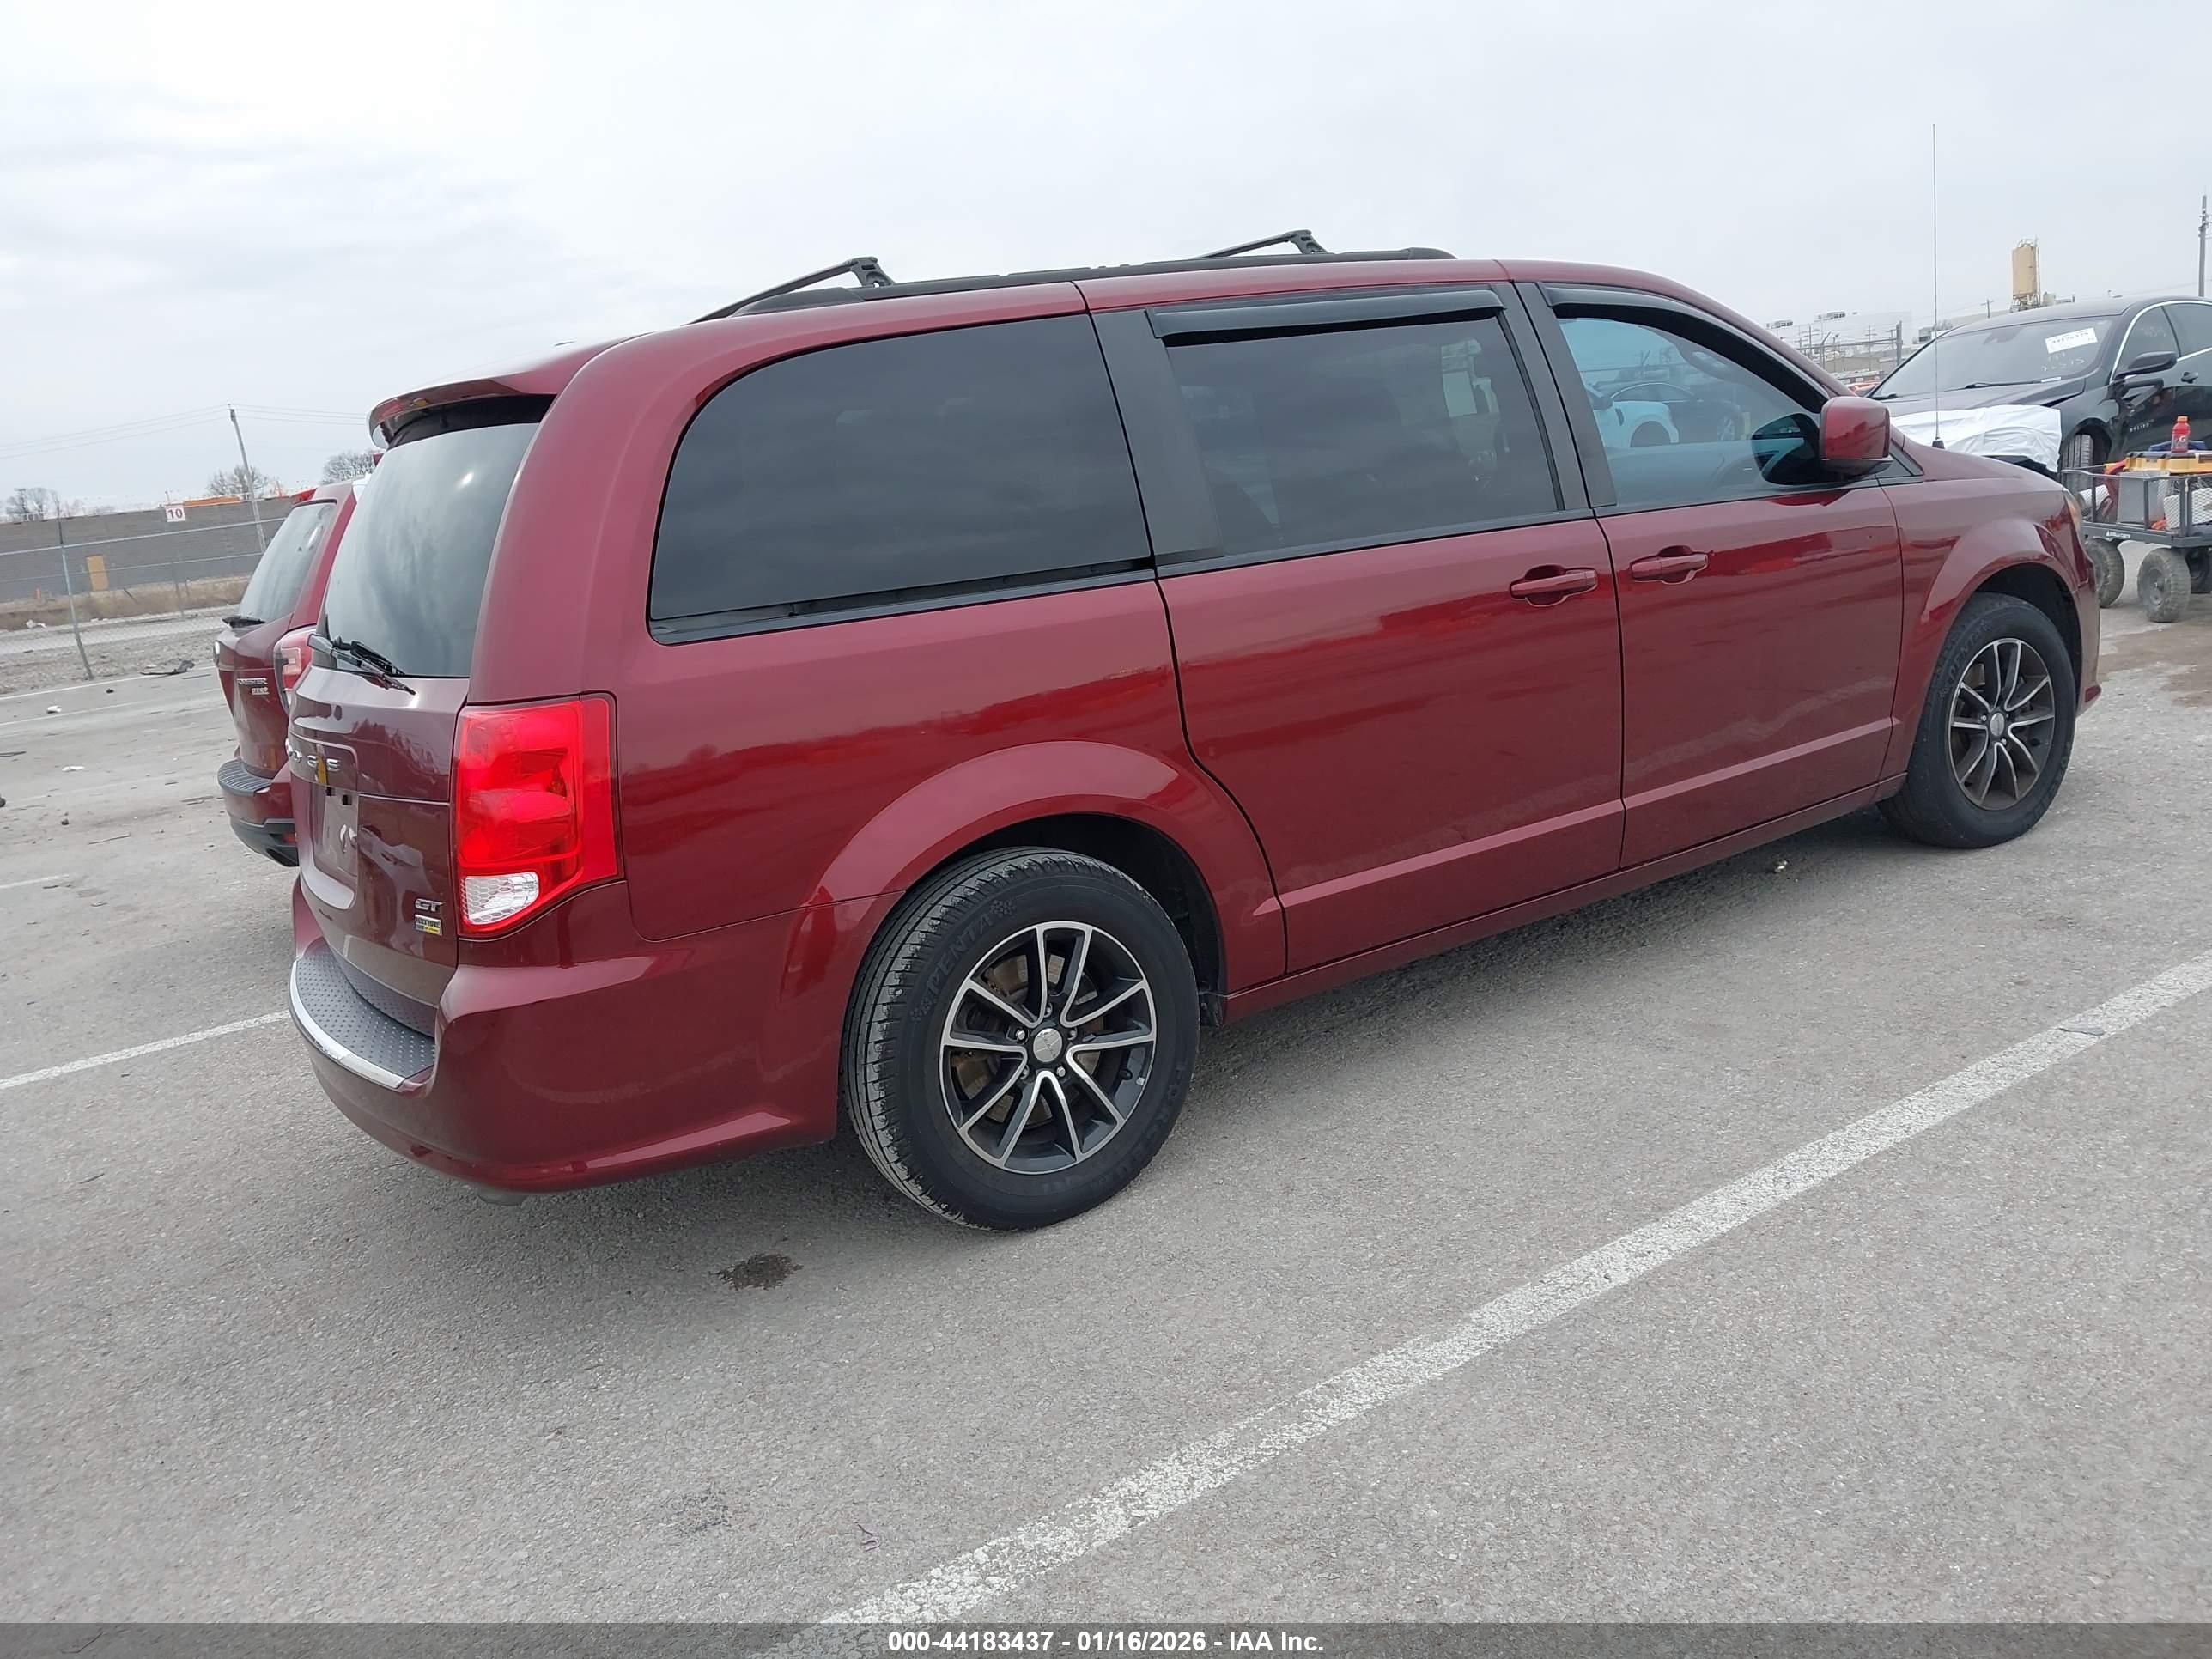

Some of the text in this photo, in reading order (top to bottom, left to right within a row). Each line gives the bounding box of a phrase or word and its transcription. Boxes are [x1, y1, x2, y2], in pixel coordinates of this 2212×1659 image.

[167, 508, 183, 519] 10
[415, 898, 443, 912] GT
[927, 913, 991, 996] PENTA
